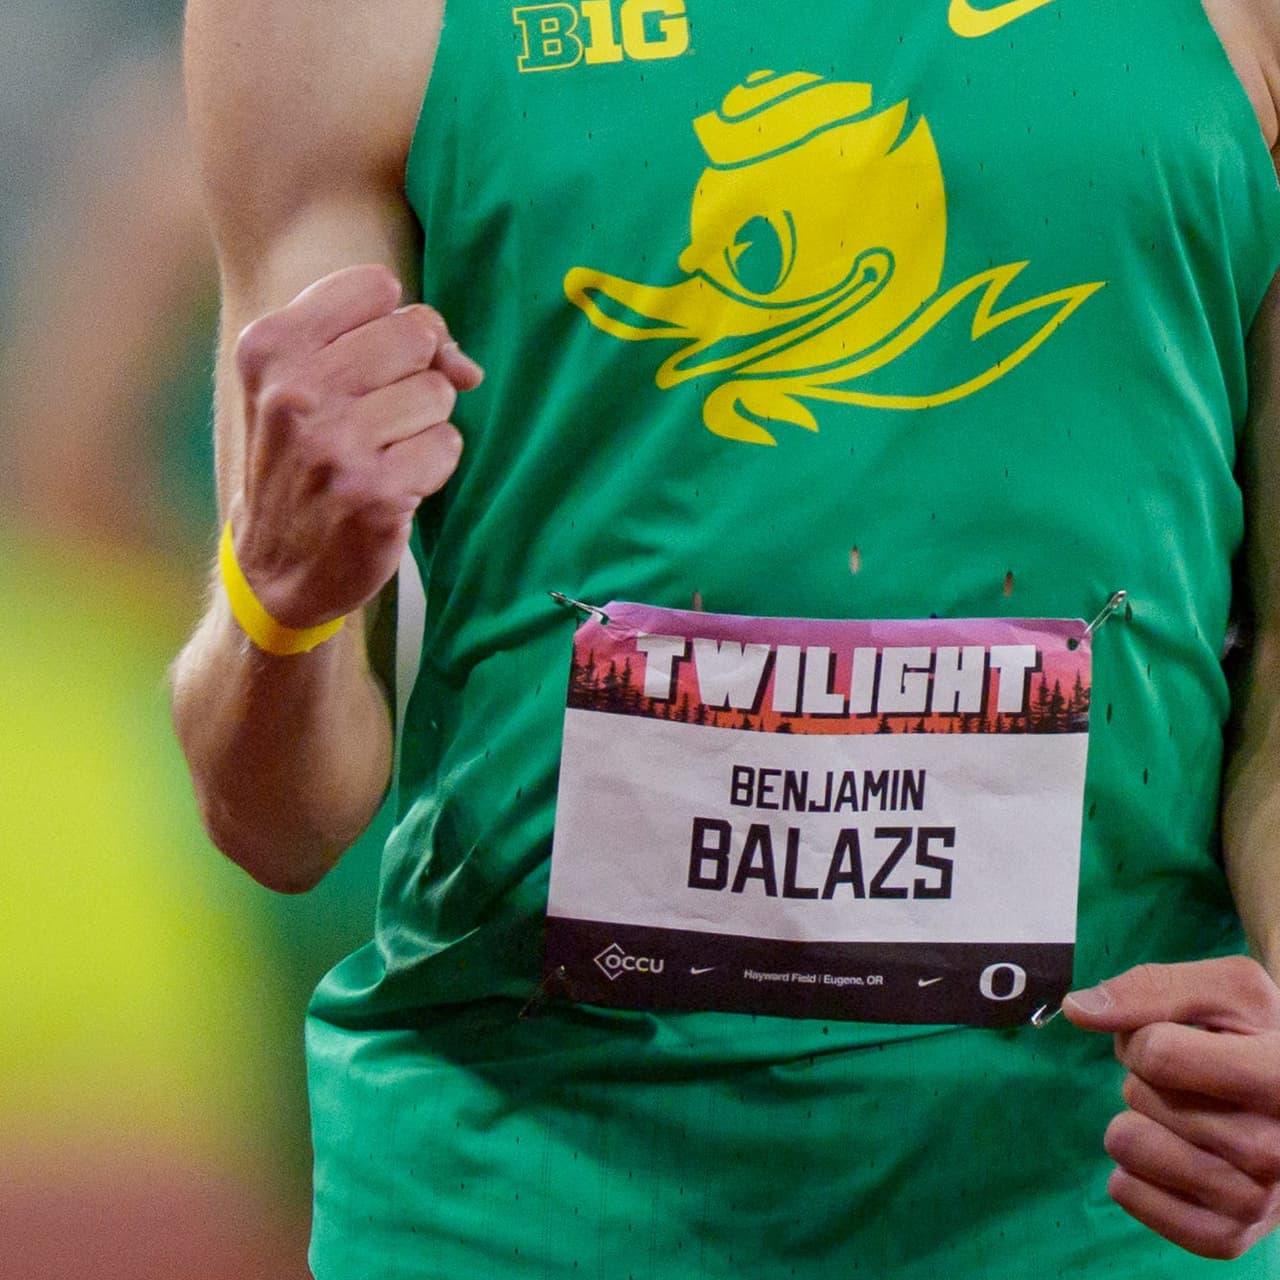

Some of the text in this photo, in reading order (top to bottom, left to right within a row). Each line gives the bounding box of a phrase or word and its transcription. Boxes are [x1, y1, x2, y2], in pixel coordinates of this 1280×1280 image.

[636, 632, 1043, 719] TWILIGHT
[730, 765, 926, 813] BENJAMIN
[687, 817, 956, 900] BALAZS
[605, 953, 665, 974] OCCU
[743, 969, 884, 987] Hayward Field Eugene, OR
